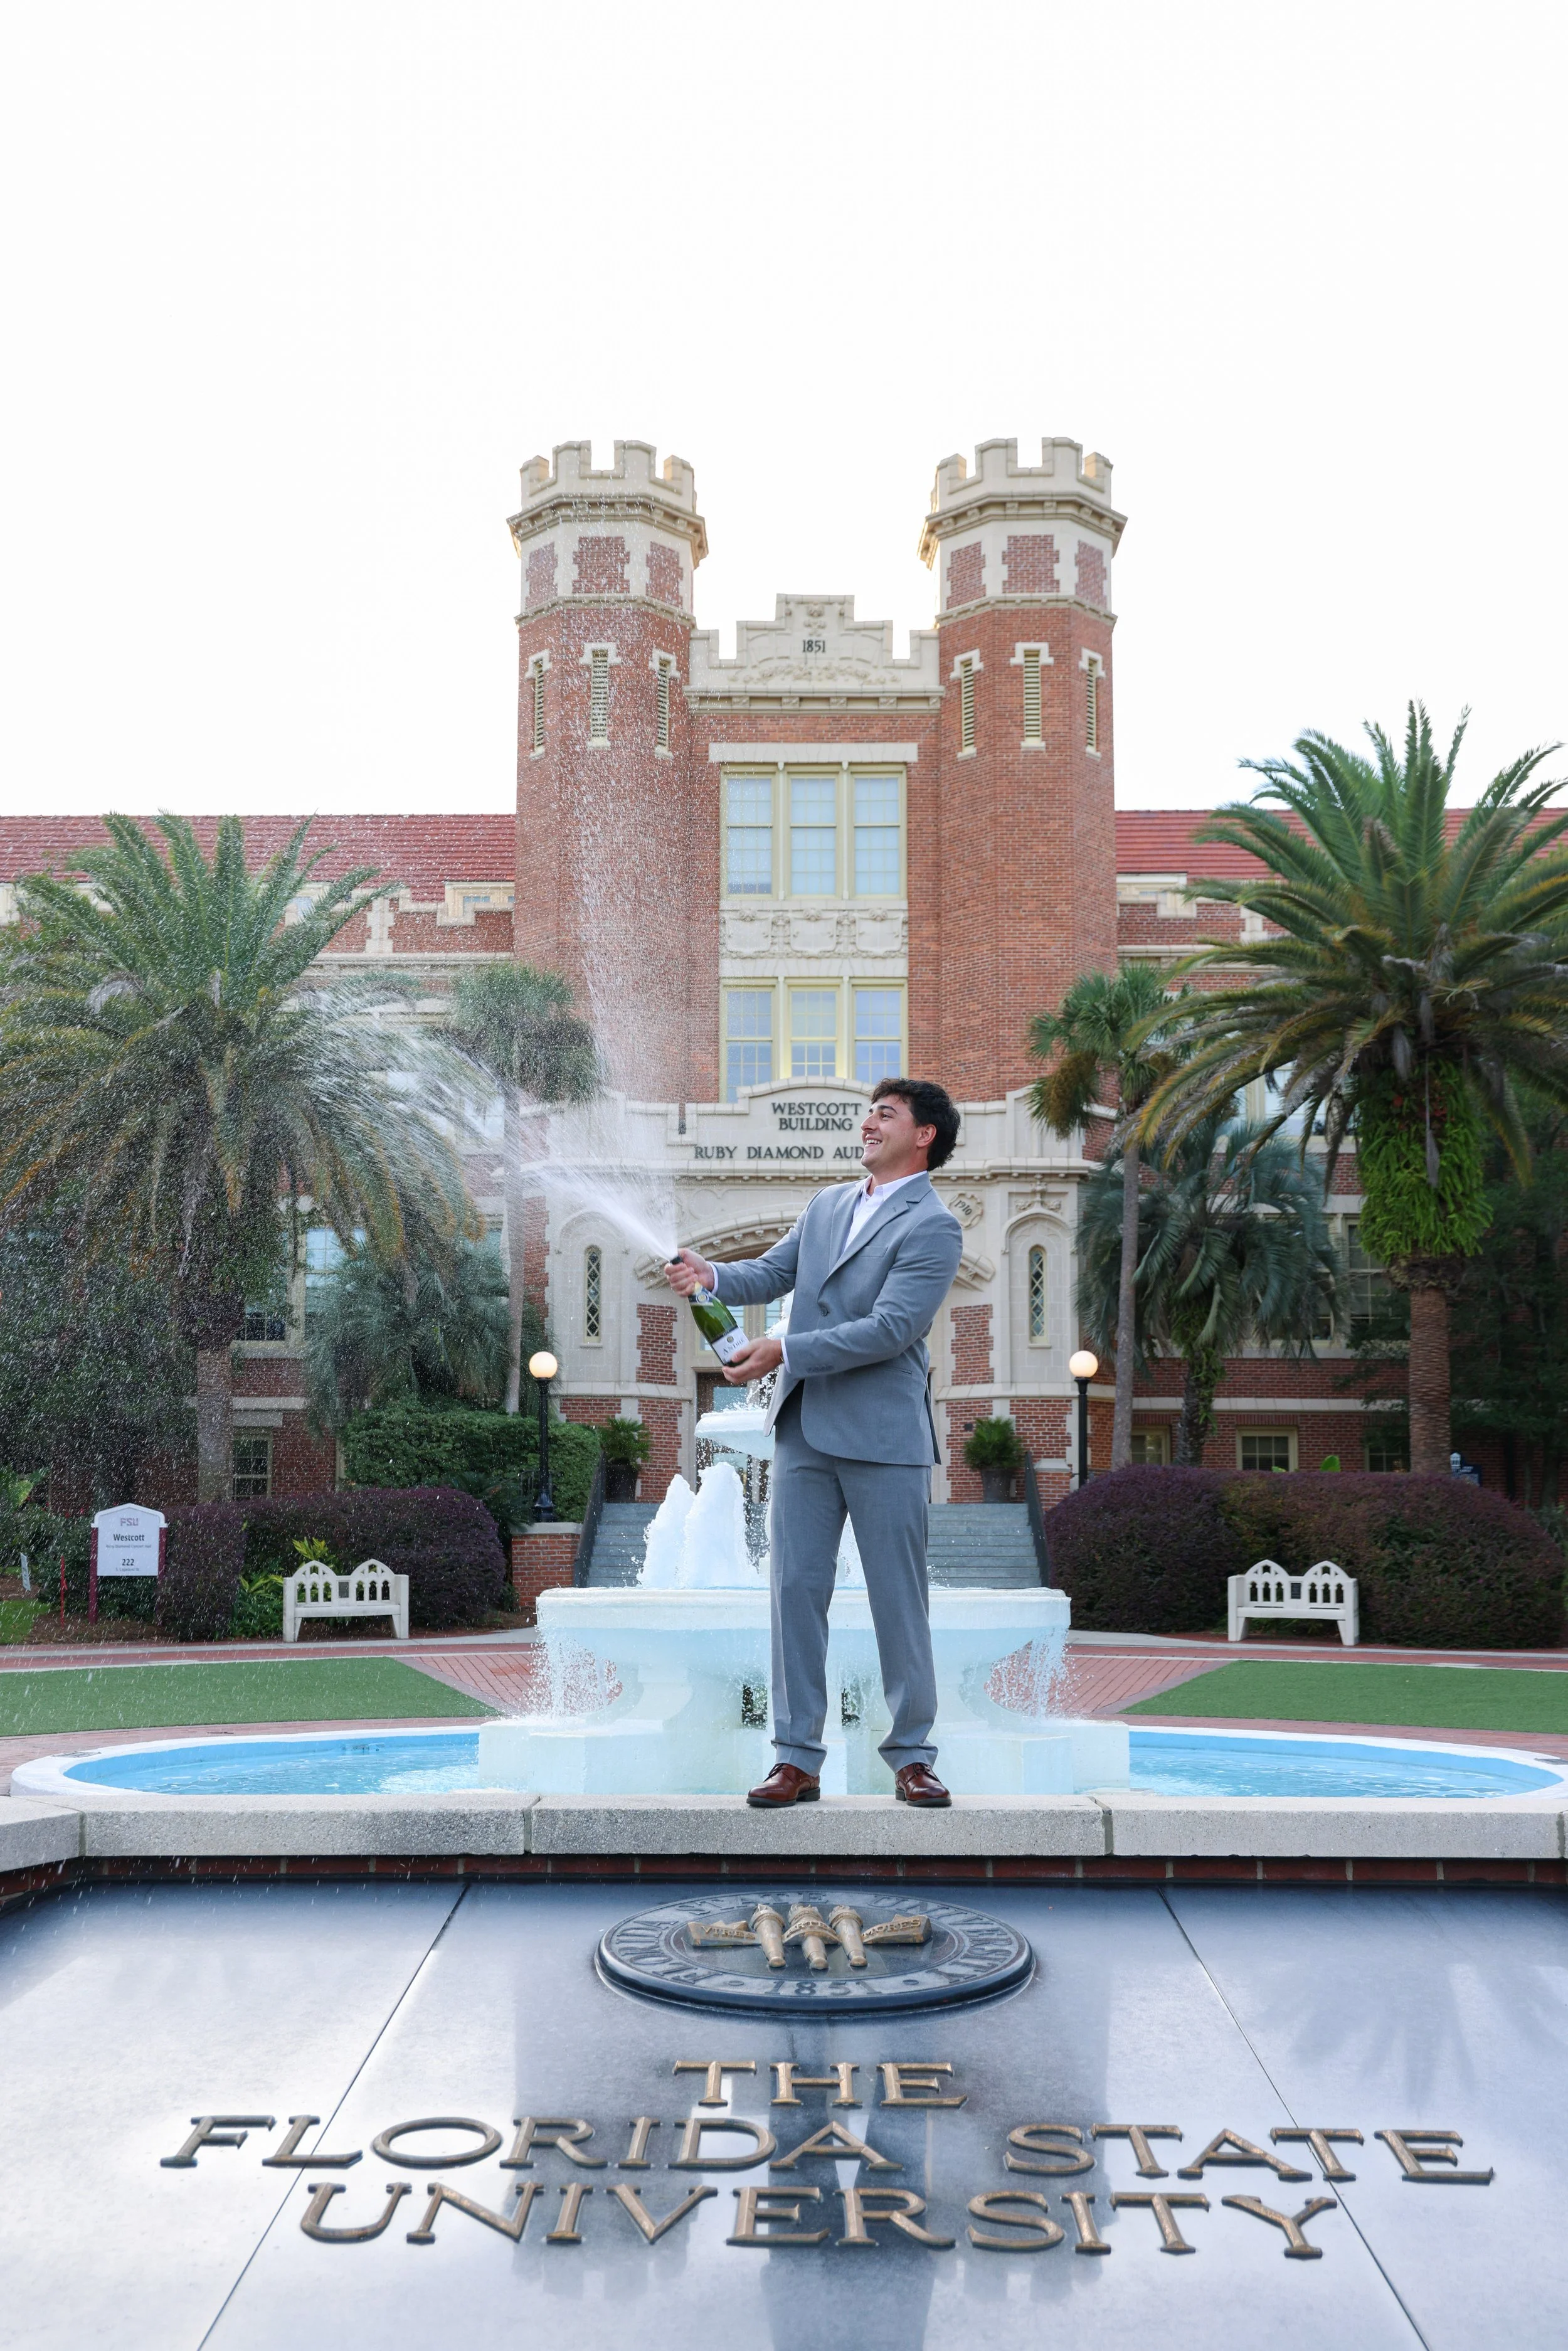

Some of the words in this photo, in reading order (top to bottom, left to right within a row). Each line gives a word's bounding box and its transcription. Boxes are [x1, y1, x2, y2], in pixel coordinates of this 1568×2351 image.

[803, 640, 825, 652] 1851
[771, 1103, 861, 1115] WESTCOTT
[779, 1118, 853, 1130] BUILDING
[694, 1145, 738, 1159] RUBY
[747, 1145, 824, 1159] DIAMOND
[120, 1518, 139, 1526] FSU
[616, 1919, 723, 1985] FLORIDA
[675, 1892, 829, 1915] STATE
[867, 1895, 1012, 1984] UNIVERSITY
[701, 1925, 756, 1940] VIRES
[764, 1980, 882, 1996] 1851
[673, 2061, 968, 2107] THE
[159, 2115, 903, 2168] FLORIDA
[1005, 2122, 1495, 2184] STATE
[299, 2181, 1338, 2259] UNIVERSITY
